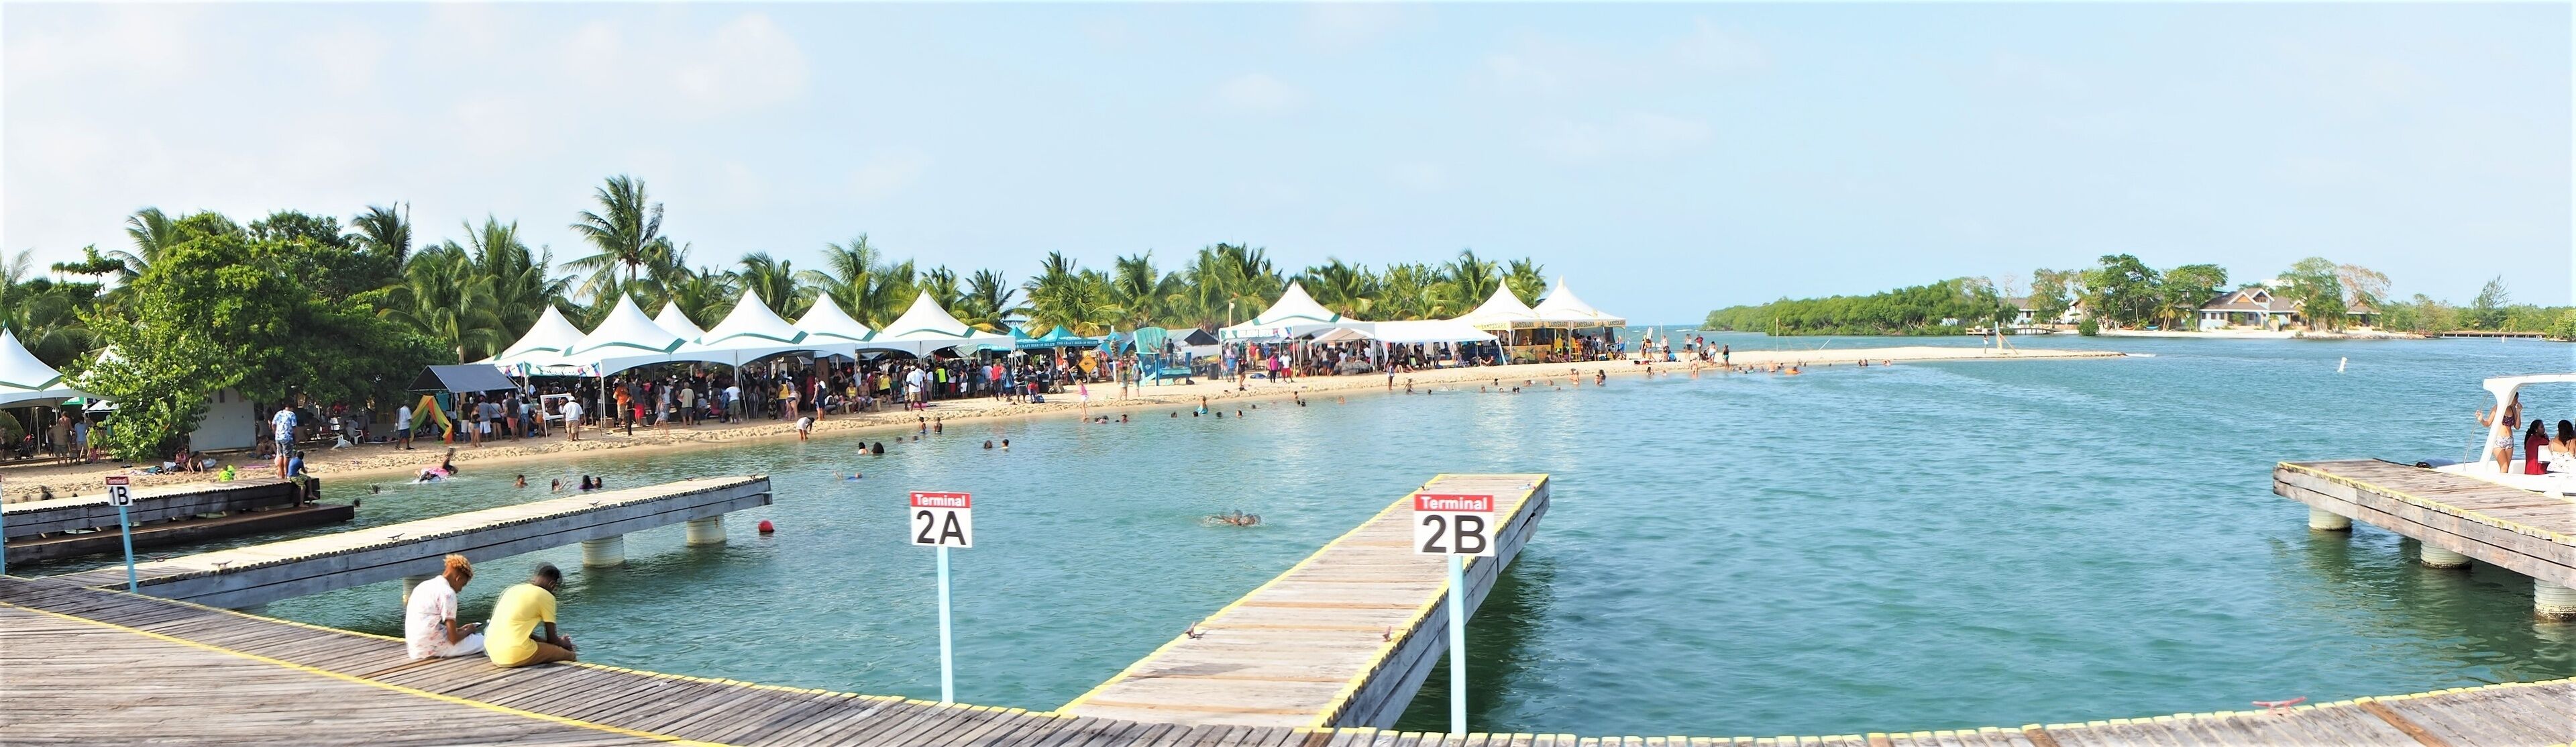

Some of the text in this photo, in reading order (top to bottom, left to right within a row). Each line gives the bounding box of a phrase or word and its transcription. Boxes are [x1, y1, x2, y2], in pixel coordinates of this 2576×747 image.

[109, 486, 129, 505] 1B
[915, 493, 966, 507] Terminal
[1420, 496, 1488, 510] Terminal
[916, 510, 966, 545] 2A
[1421, 514, 1487, 554] 2B
